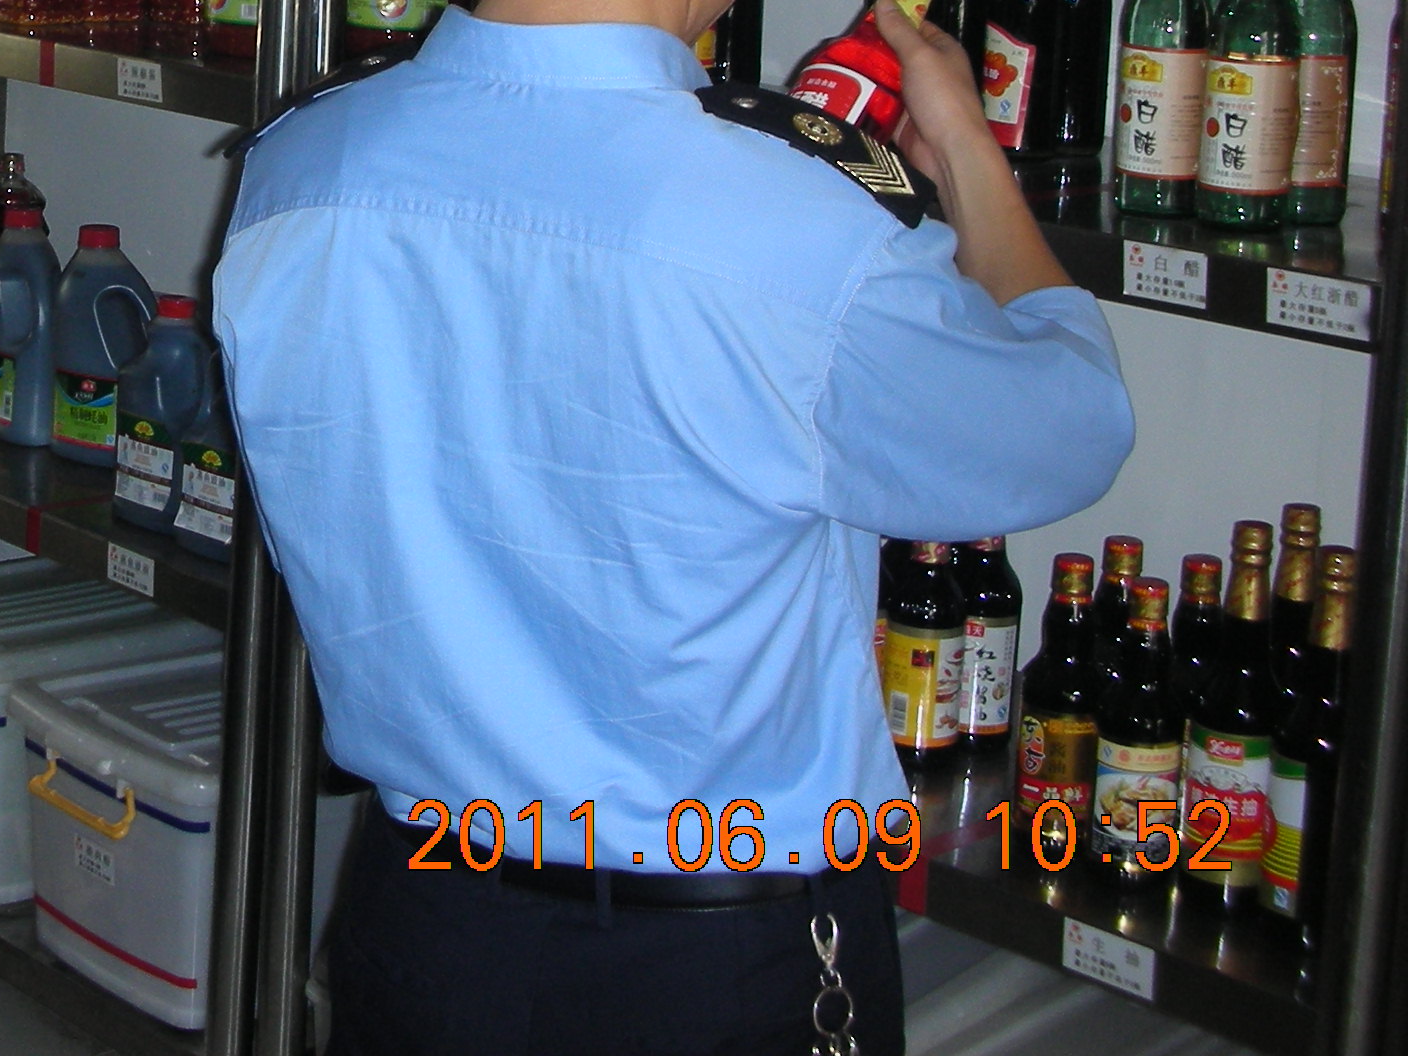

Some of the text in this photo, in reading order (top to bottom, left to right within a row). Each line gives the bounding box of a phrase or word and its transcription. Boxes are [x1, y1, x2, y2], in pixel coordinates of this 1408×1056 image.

[1133, 99, 1159, 157] 白醋
[1221, 113, 1248, 171] 白醋
[1154, 254, 1200, 278] 白醋
[1295, 282, 1359, 308] 大红浙醋
